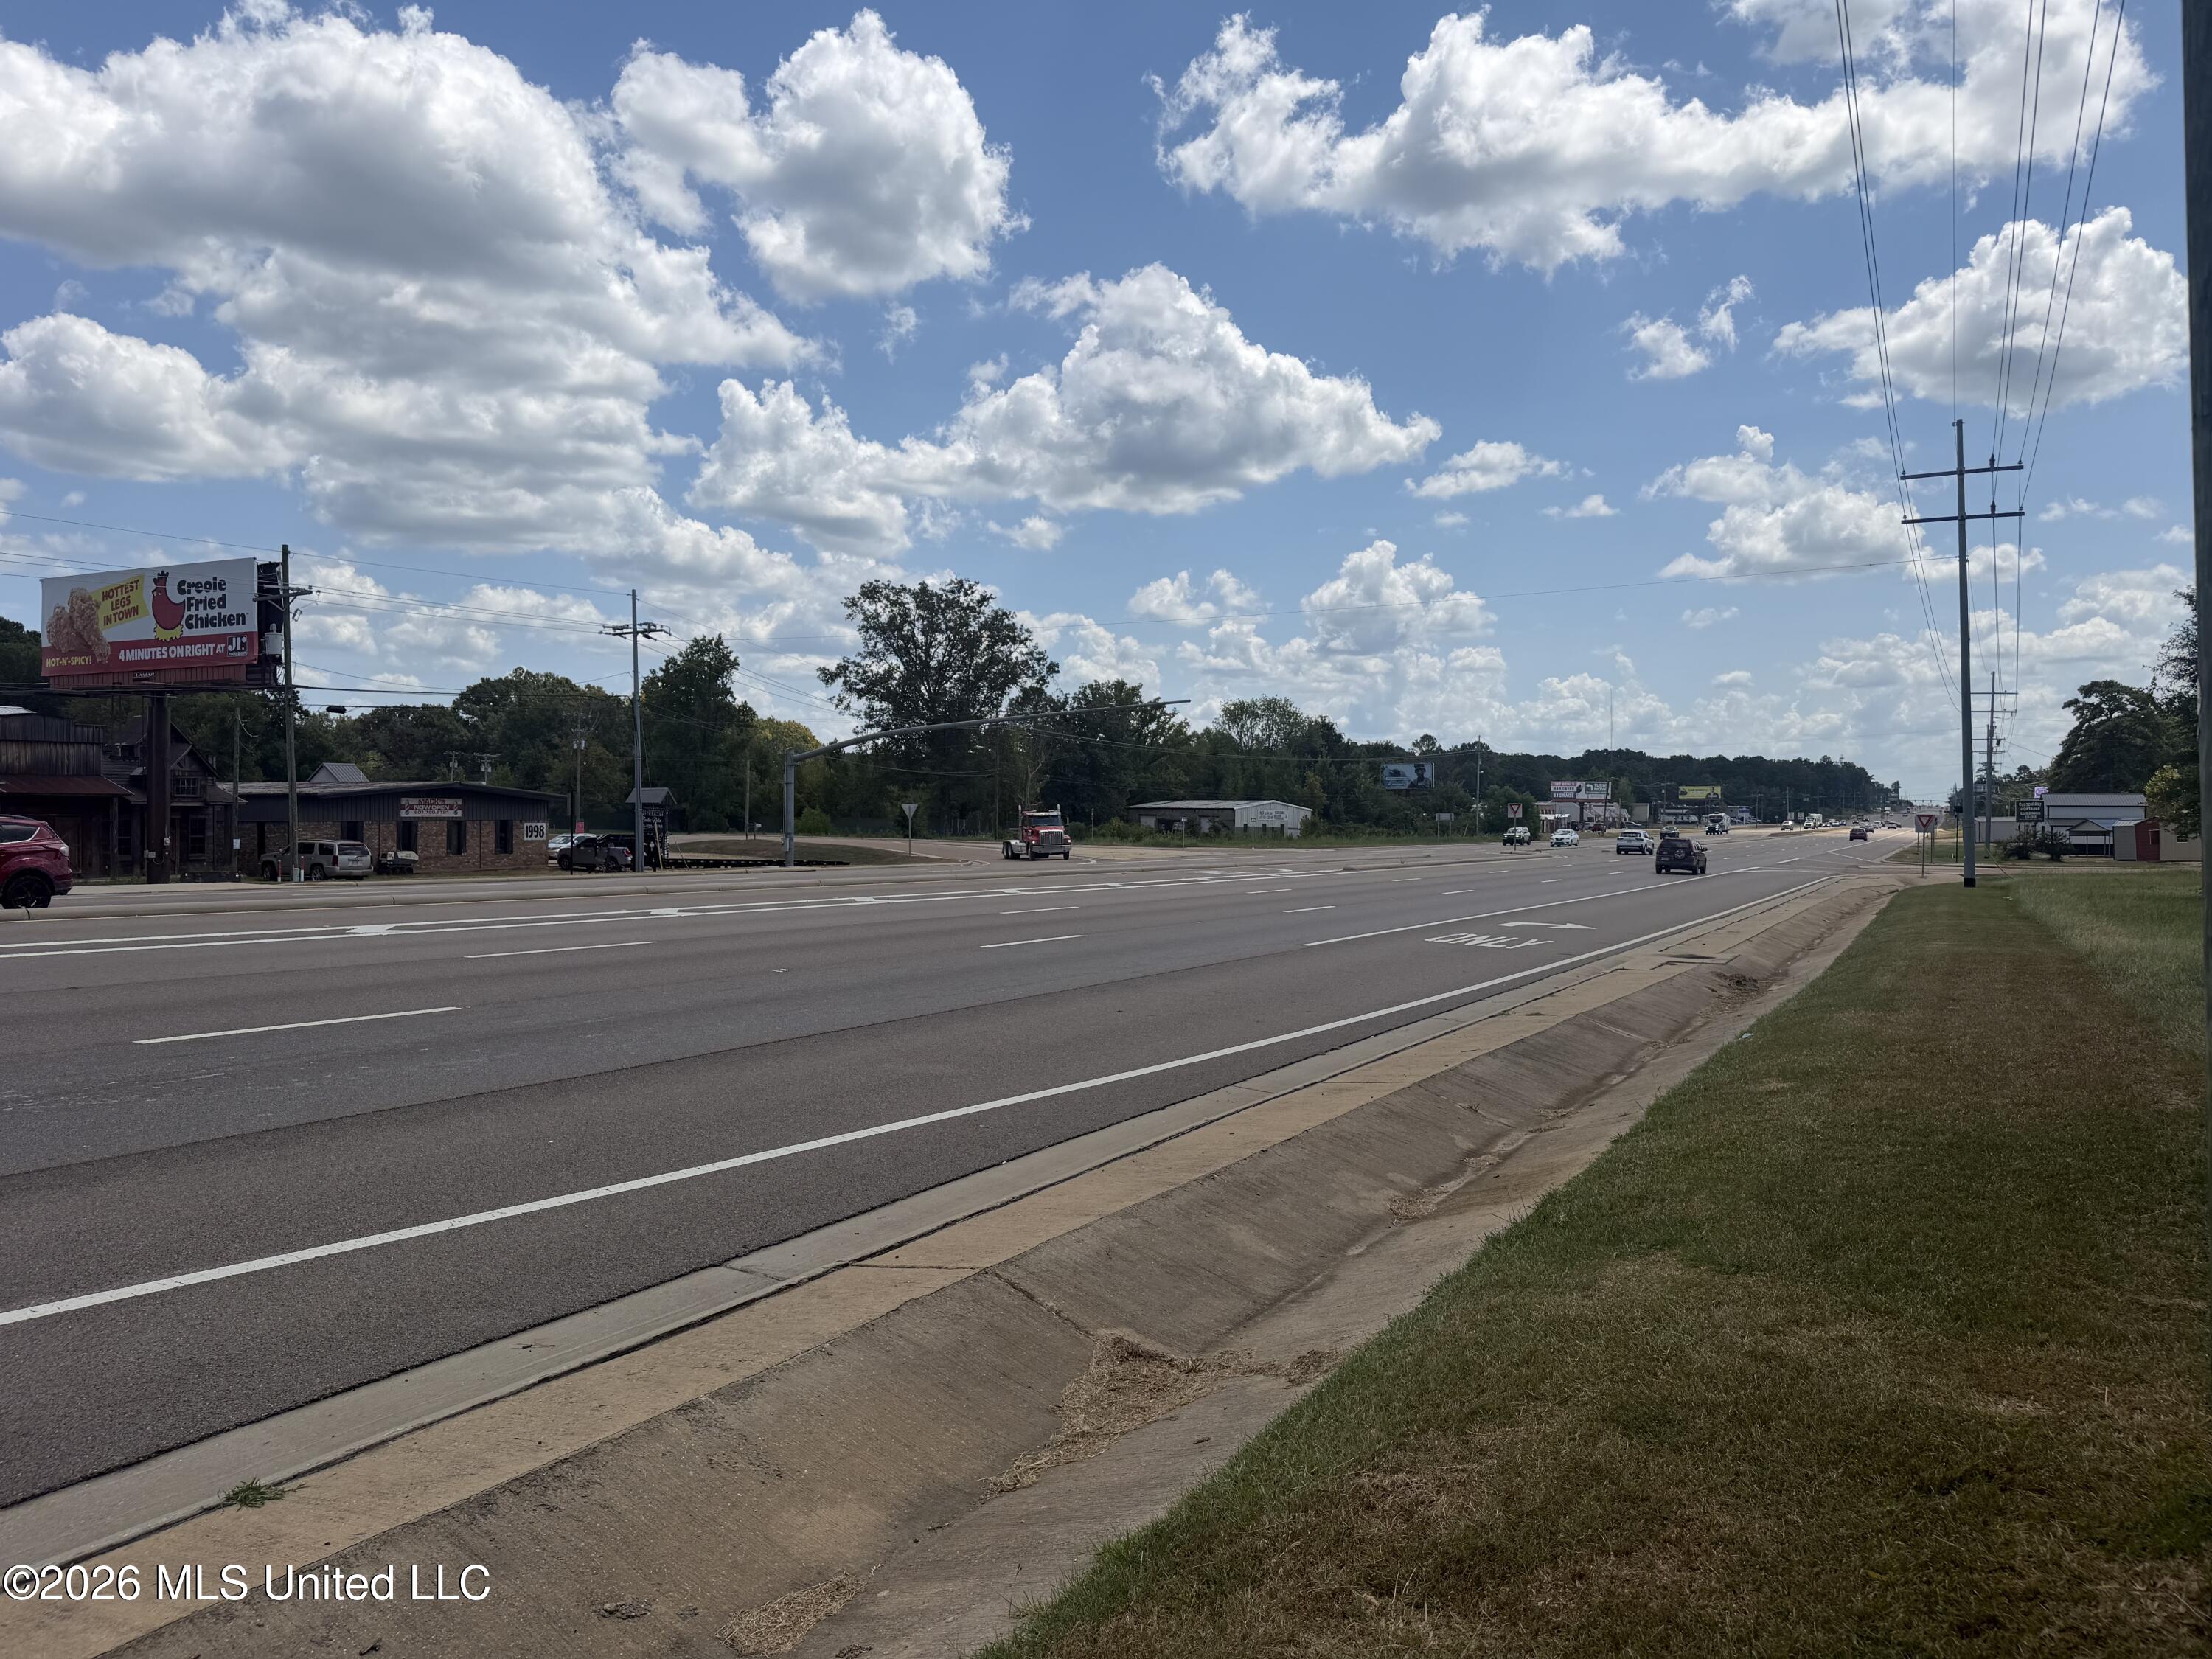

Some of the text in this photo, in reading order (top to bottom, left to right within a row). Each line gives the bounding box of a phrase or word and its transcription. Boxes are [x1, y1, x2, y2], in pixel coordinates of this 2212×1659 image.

[102, 579, 139, 602] HOTTEST
[177, 577, 226, 595] Creole
[111, 595, 131, 611] LEGS
[186, 594, 226, 611] Fried
[103, 605, 139, 626] IN TOWN
[184, 612, 246, 629] Chicken
[118, 650, 125, 661] 4
[125, 647, 168, 661] MINUTES
[168, 645, 184, 658] ON
[184, 644, 215, 657] RIGHT
[215, 644, 226, 653] AT
[526, 825, 545, 838] 1998
[1424, 933, 1555, 950] ONLY
